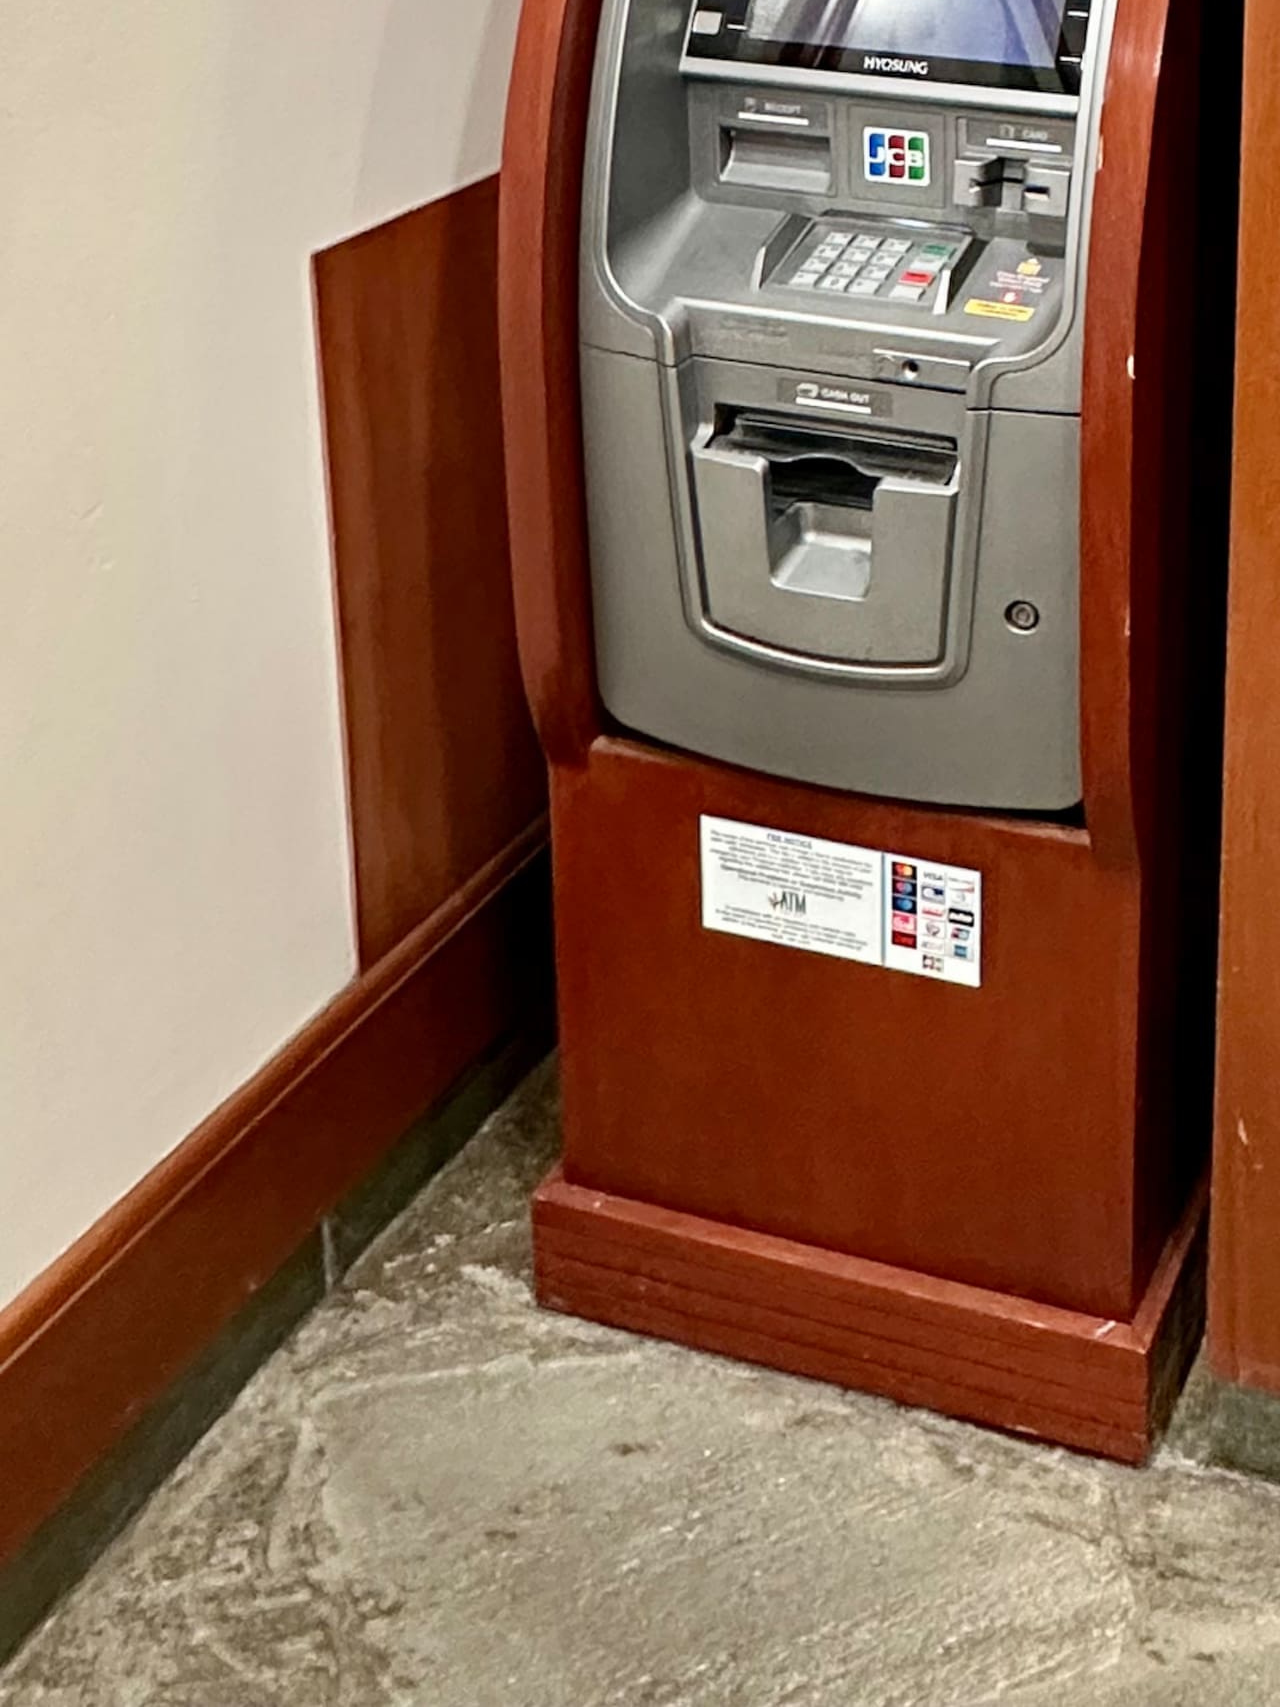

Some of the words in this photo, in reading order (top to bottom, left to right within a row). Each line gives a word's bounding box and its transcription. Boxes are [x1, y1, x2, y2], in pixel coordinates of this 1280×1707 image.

[863, 55, 929, 75] HYOSUNG
[820, 387, 849, 401] CASH
[850, 391, 871, 404] OUT
[780, 891, 807, 914] ATM
